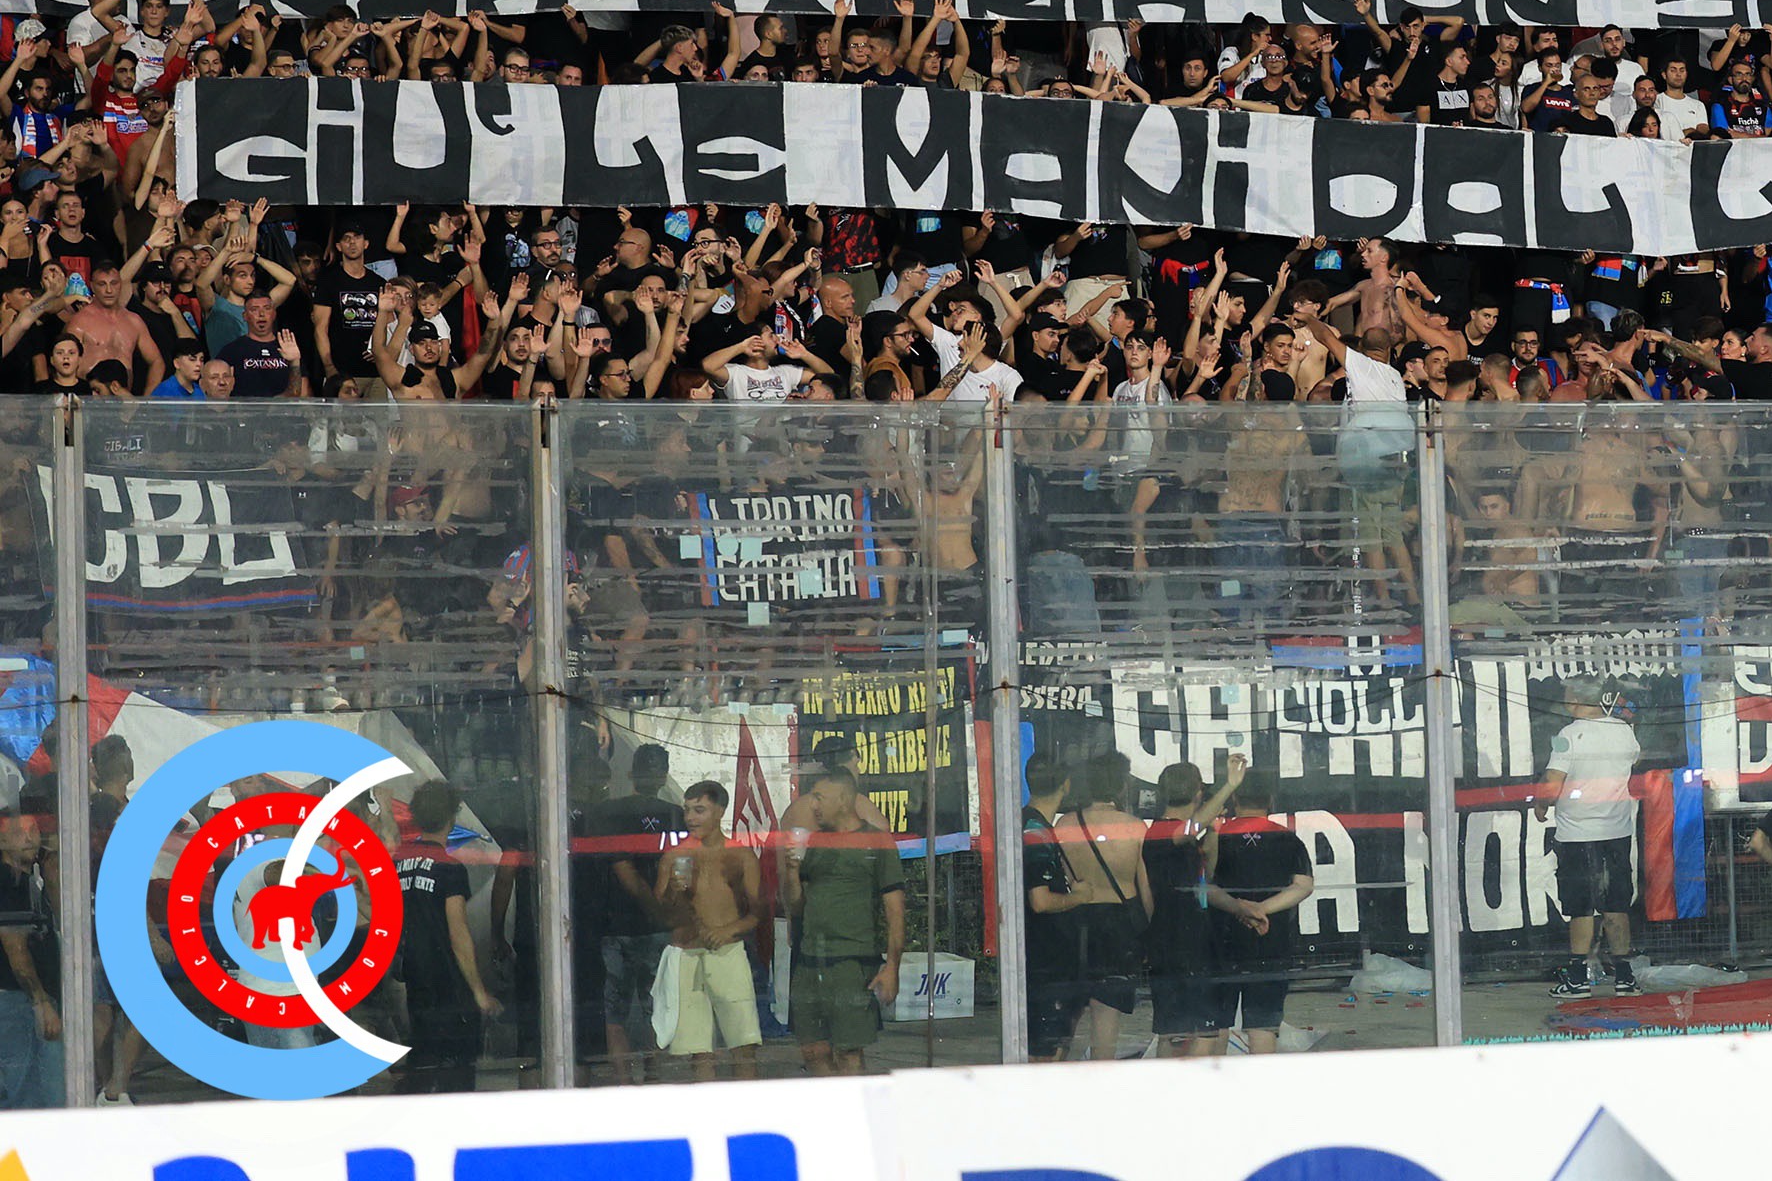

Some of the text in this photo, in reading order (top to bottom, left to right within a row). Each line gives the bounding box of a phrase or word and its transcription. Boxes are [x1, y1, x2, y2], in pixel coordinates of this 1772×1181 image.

[561, 81, 787, 207] LE
[862, 85, 1251, 232] MANI
[1312, 117, 1634, 255] DAL
[243, 357, 289, 370] CATANIA
[884, 724, 951, 774] RIBELE
